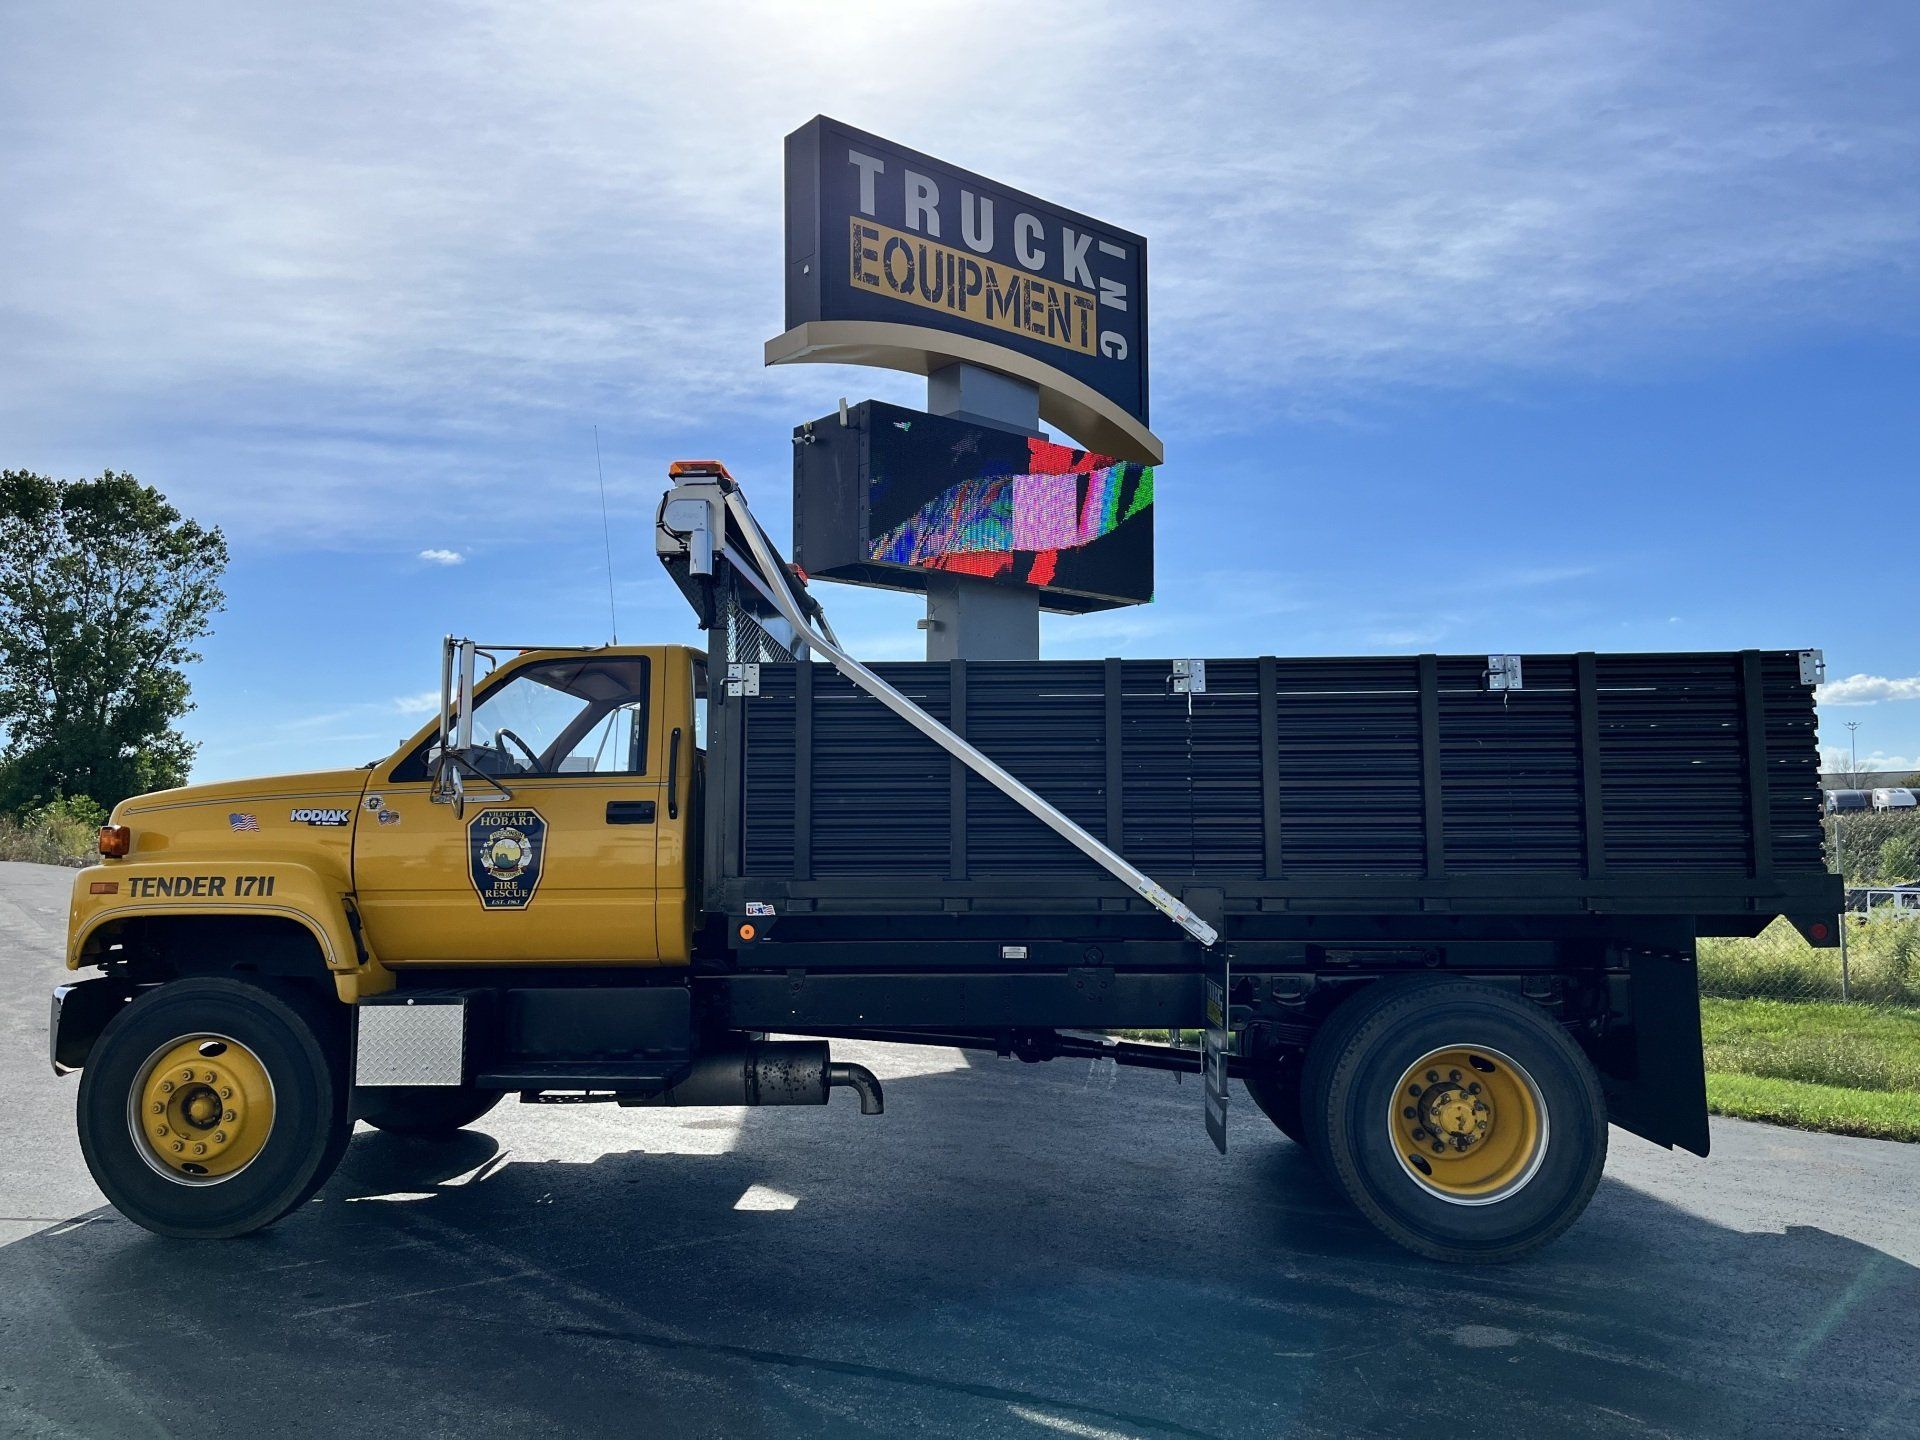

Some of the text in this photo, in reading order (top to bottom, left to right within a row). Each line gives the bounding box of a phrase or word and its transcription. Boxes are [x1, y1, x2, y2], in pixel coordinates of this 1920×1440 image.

[848, 149, 1095, 290] TRUCK
[852, 223, 1095, 348] EQUIPMENT
[1098, 240, 1128, 361] INC
[290, 808, 351, 822] KODIAK
[480, 816, 536, 826] HOBART
[128, 876, 275, 898] TENDER 1711
[494, 881, 518, 890] FIRE
[485, 889, 529, 898] RESCUE
[747, 907, 764, 915] USA
